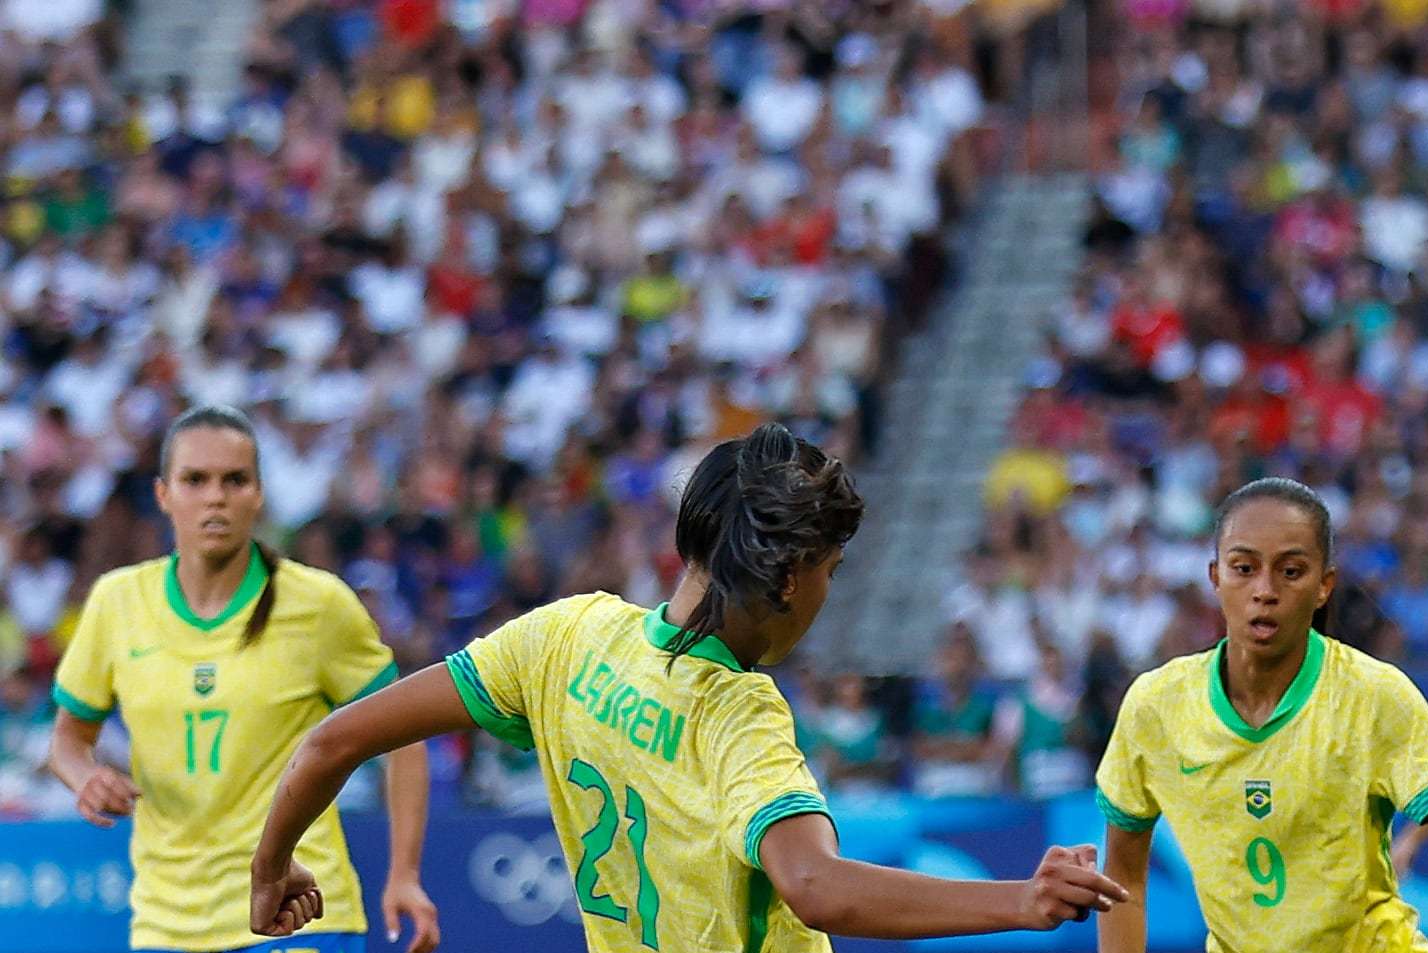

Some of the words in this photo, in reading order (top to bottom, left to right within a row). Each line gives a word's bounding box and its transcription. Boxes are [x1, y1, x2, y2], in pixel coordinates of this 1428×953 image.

[183, 708, 230, 776] 17
[567, 757, 661, 952] 21
[1246, 836, 1288, 908] 9
